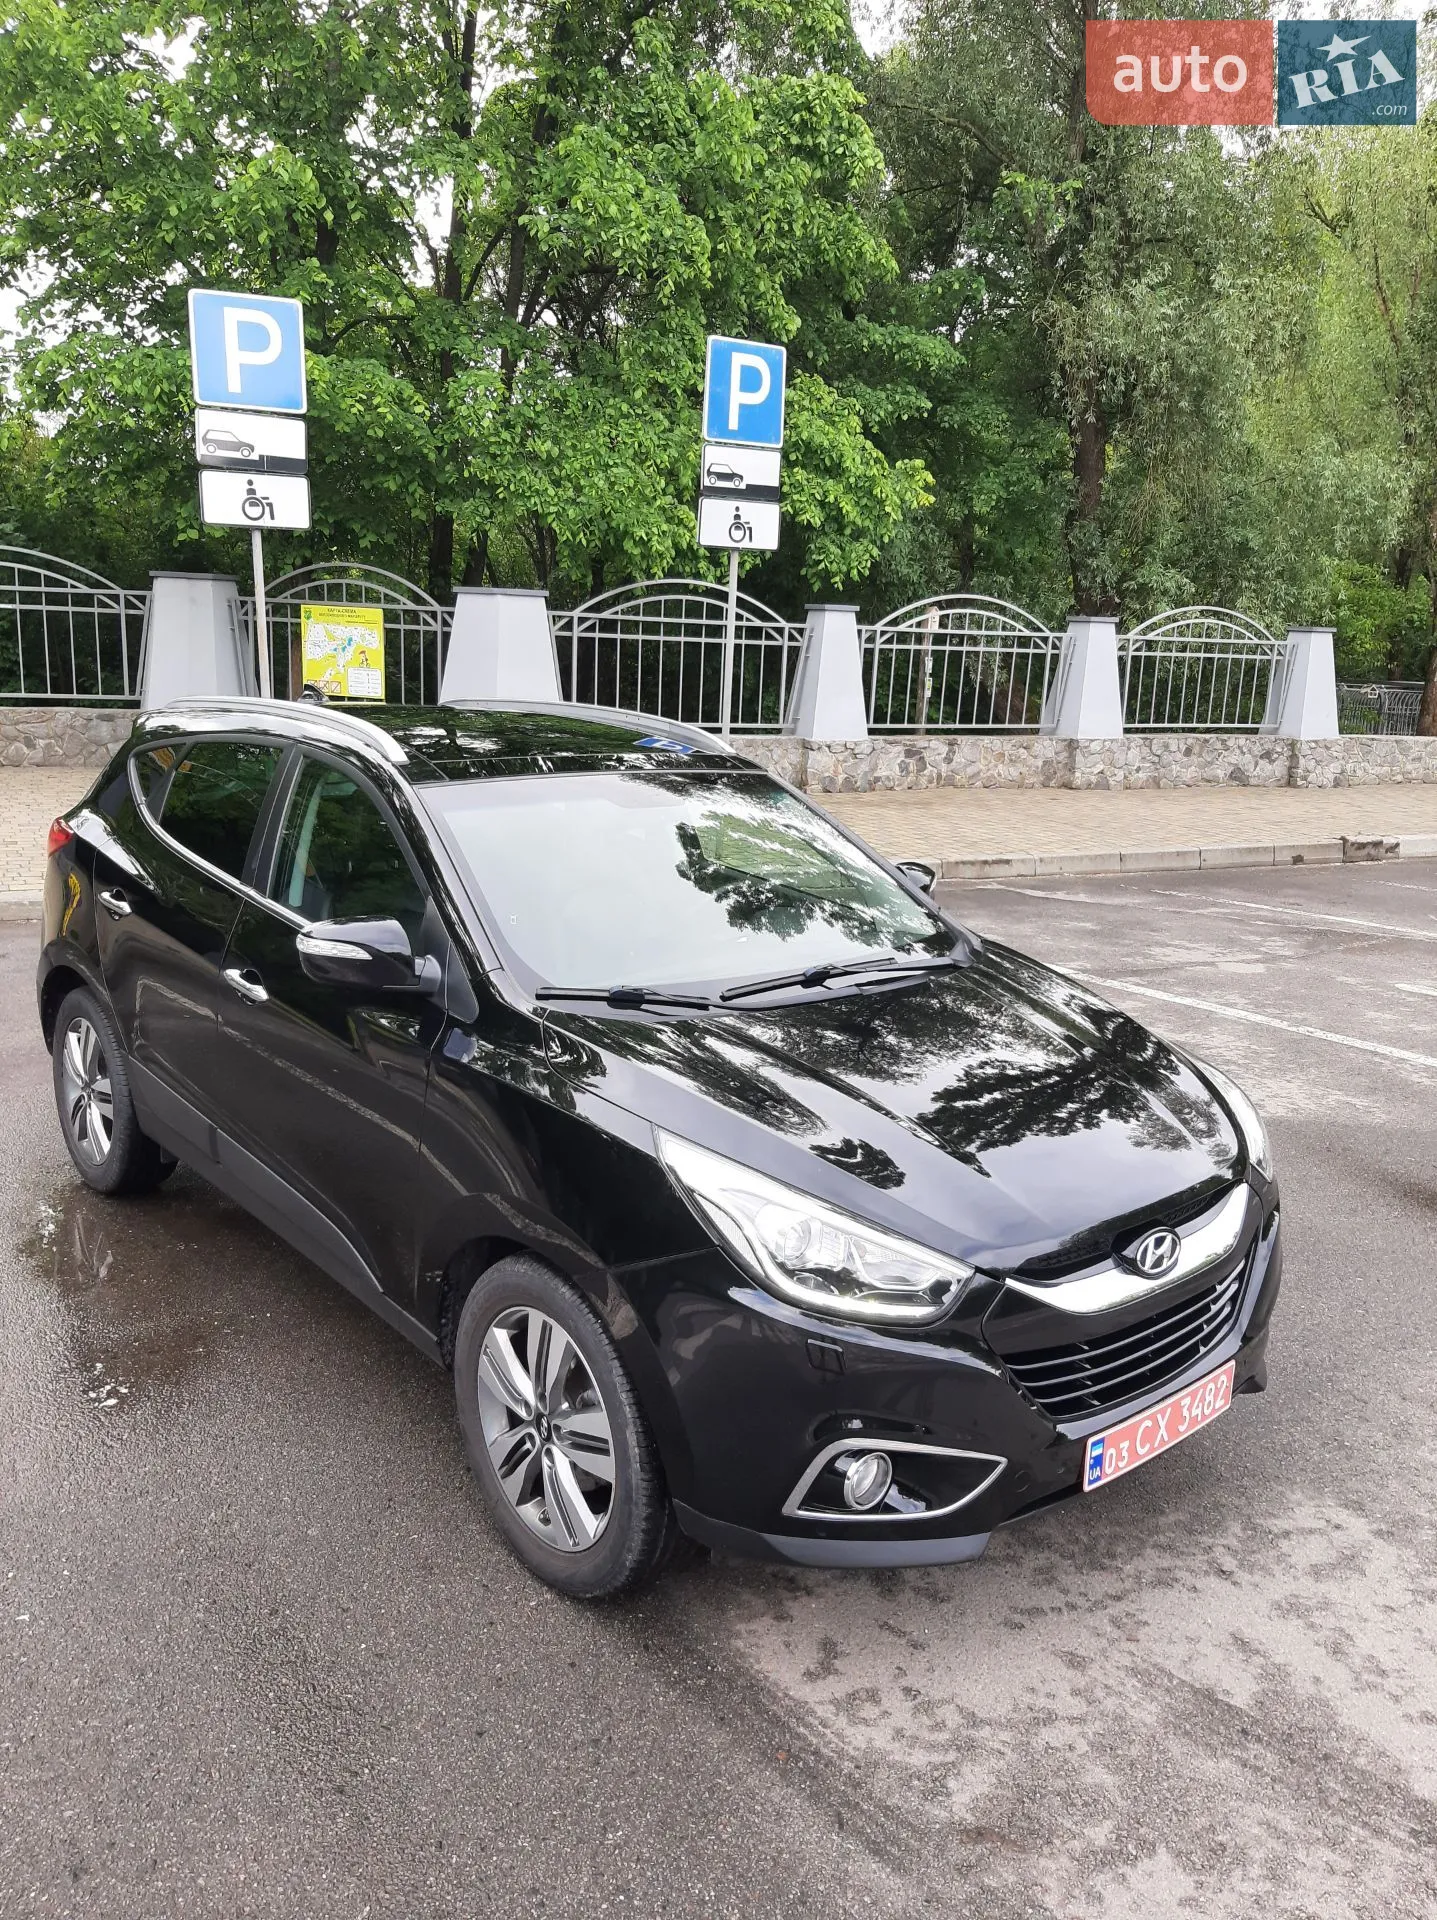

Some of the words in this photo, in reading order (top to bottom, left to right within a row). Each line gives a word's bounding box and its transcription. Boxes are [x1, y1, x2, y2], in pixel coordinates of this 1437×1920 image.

[223, 306, 283, 394] P
[728, 351, 771, 431] P
[1104, 1440, 1130, 1475] 03
[1135, 1407, 1172, 1456] CX
[1177, 1374, 1229, 1433] 3482
[1089, 1469, 1101, 1481] UA
